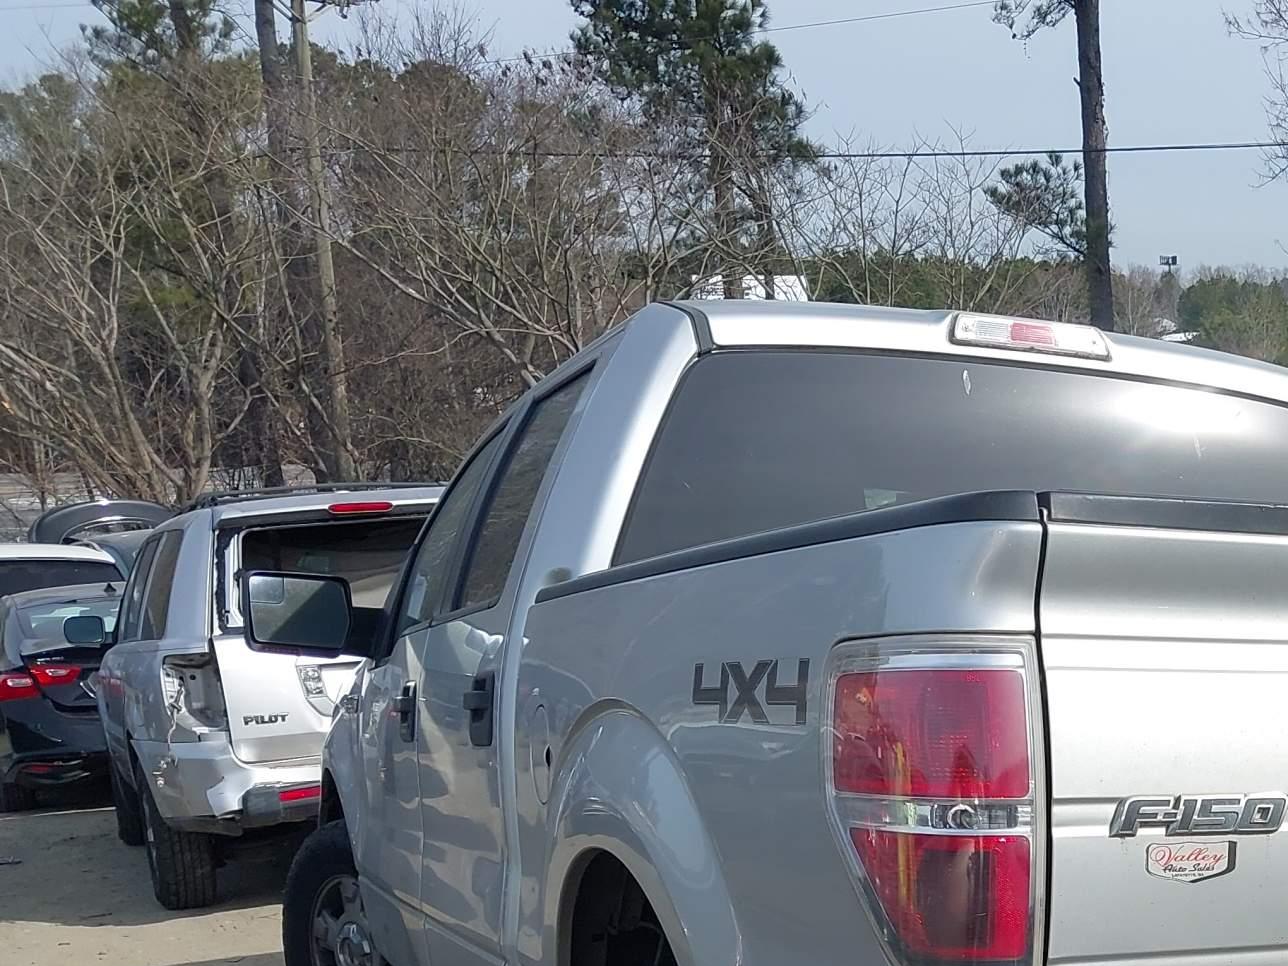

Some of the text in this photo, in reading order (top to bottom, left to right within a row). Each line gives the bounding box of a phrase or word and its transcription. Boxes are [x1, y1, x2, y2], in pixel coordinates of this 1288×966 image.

[242, 712, 289, 726] PILOT
[1109, 793, 1288, 837] F-150
[1150, 845, 1227, 867] Valley
